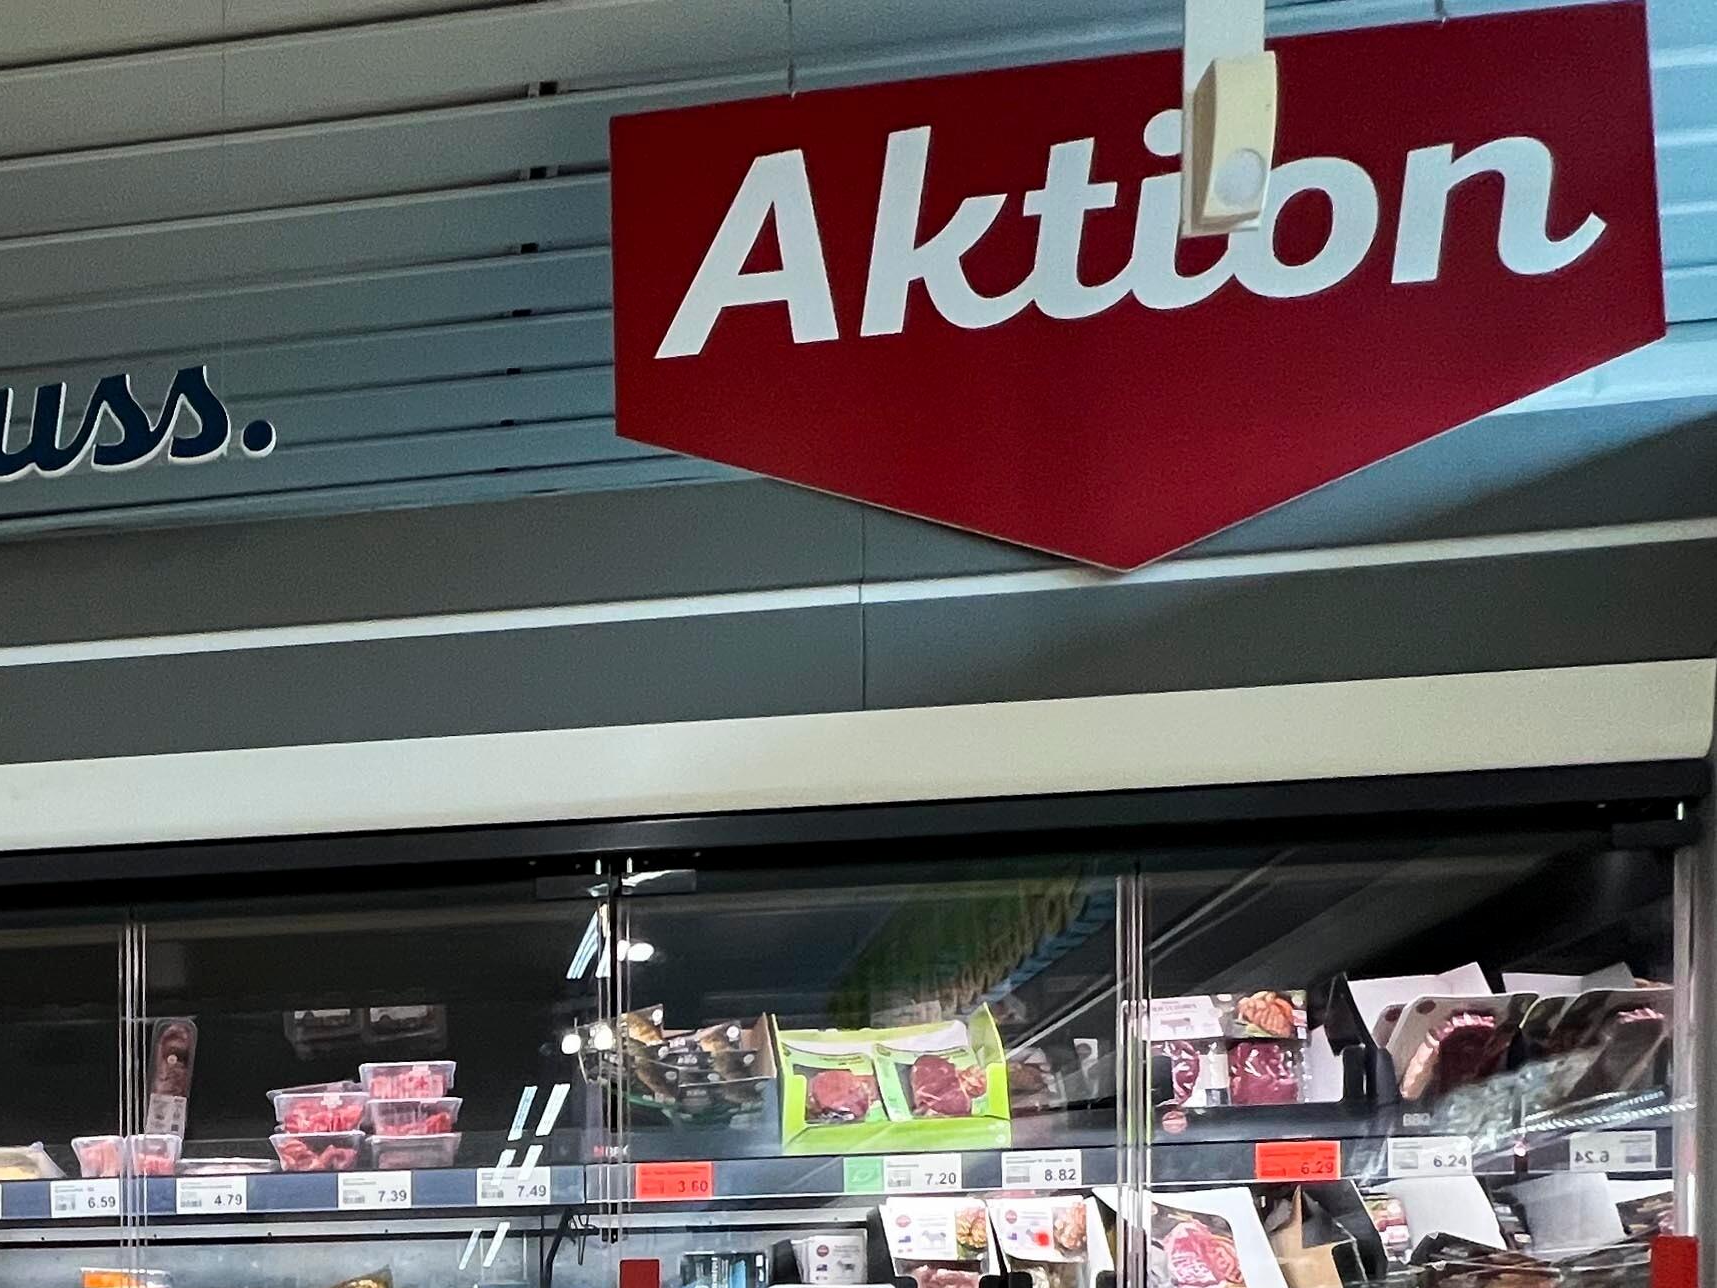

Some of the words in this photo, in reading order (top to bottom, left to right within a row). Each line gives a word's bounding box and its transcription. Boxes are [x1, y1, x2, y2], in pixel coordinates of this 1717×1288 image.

[653, 109, 1606, 358] Aktion
[1434, 1154, 1467, 1167] 6.24
[1301, 1162, 1334, 1175] 6.29
[925, 1172, 956, 1185] 7.20
[1045, 1169, 1076, 1181] 8.82
[378, 1190, 407, 1202] 7.39
[517, 1185, 546, 1197] 7.49
[88, 1196, 115, 1208] 6.59
[215, 1194, 242, 1206] 4.79
